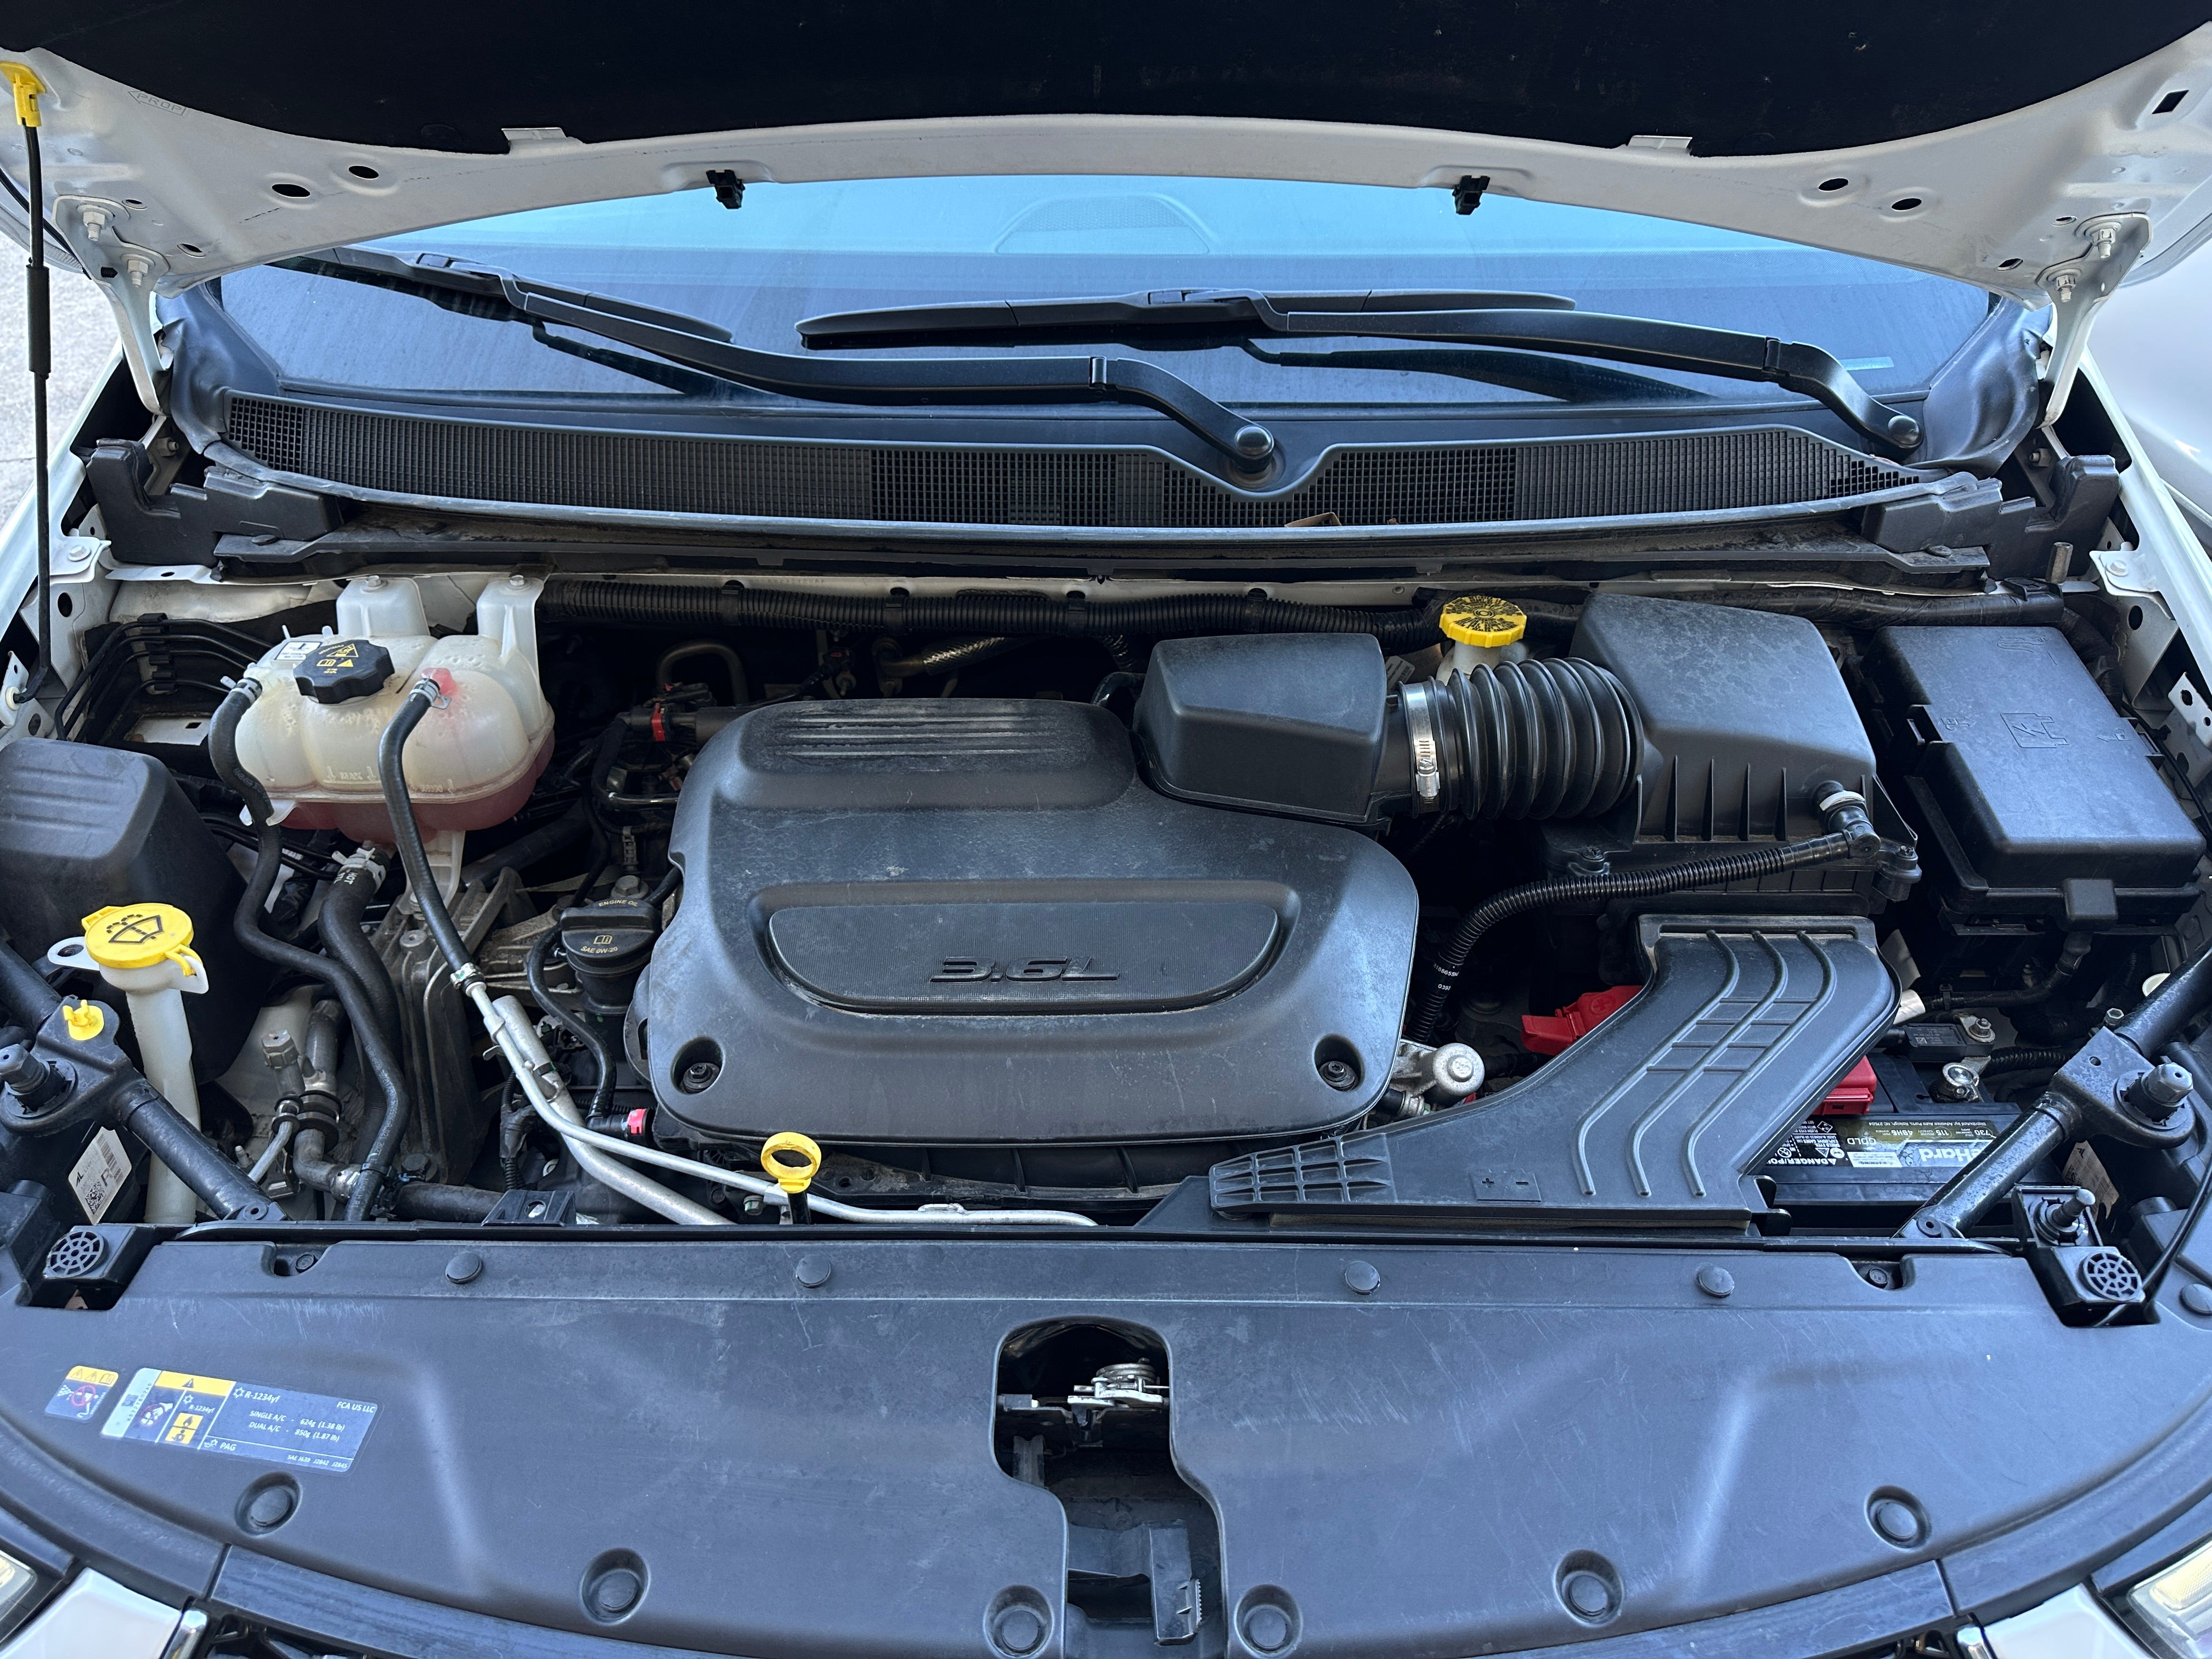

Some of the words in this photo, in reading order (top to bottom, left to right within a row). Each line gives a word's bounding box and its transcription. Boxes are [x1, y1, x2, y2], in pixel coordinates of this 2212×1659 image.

[137, 93, 182, 111] PROP
[344, 872, 358, 884] HOT
[599, 899, 627, 907] ENGINE
[930, 956, 1120, 983] 3.6L
[1918, 1148, 1982, 1161] eHard
[100, 1167, 114, 1187] R
[244, 1391, 281, 1404] R-1234yf
[188, 1404, 216, 1414] R-1234yf
[336, 1401, 351, 1410] FCA
[362, 1405, 376, 1413] LLC
[249, 1410, 273, 1420] SINGLE
[273, 1414, 286, 1422] A/C
[300, 1418, 316, 1427] 624g
[318, 1420, 335, 1429] (1.38
[335, 1423, 346, 1432] lb)
[249, 1421, 267, 1430] DUAL
[267, 1424, 281, 1432] A/C
[294, 1429, 312, 1438] 850g
[313, 1431, 330, 1440] (1.87
[331, 1434, 340, 1443] lb)
[220, 1442, 237, 1452] PAG
